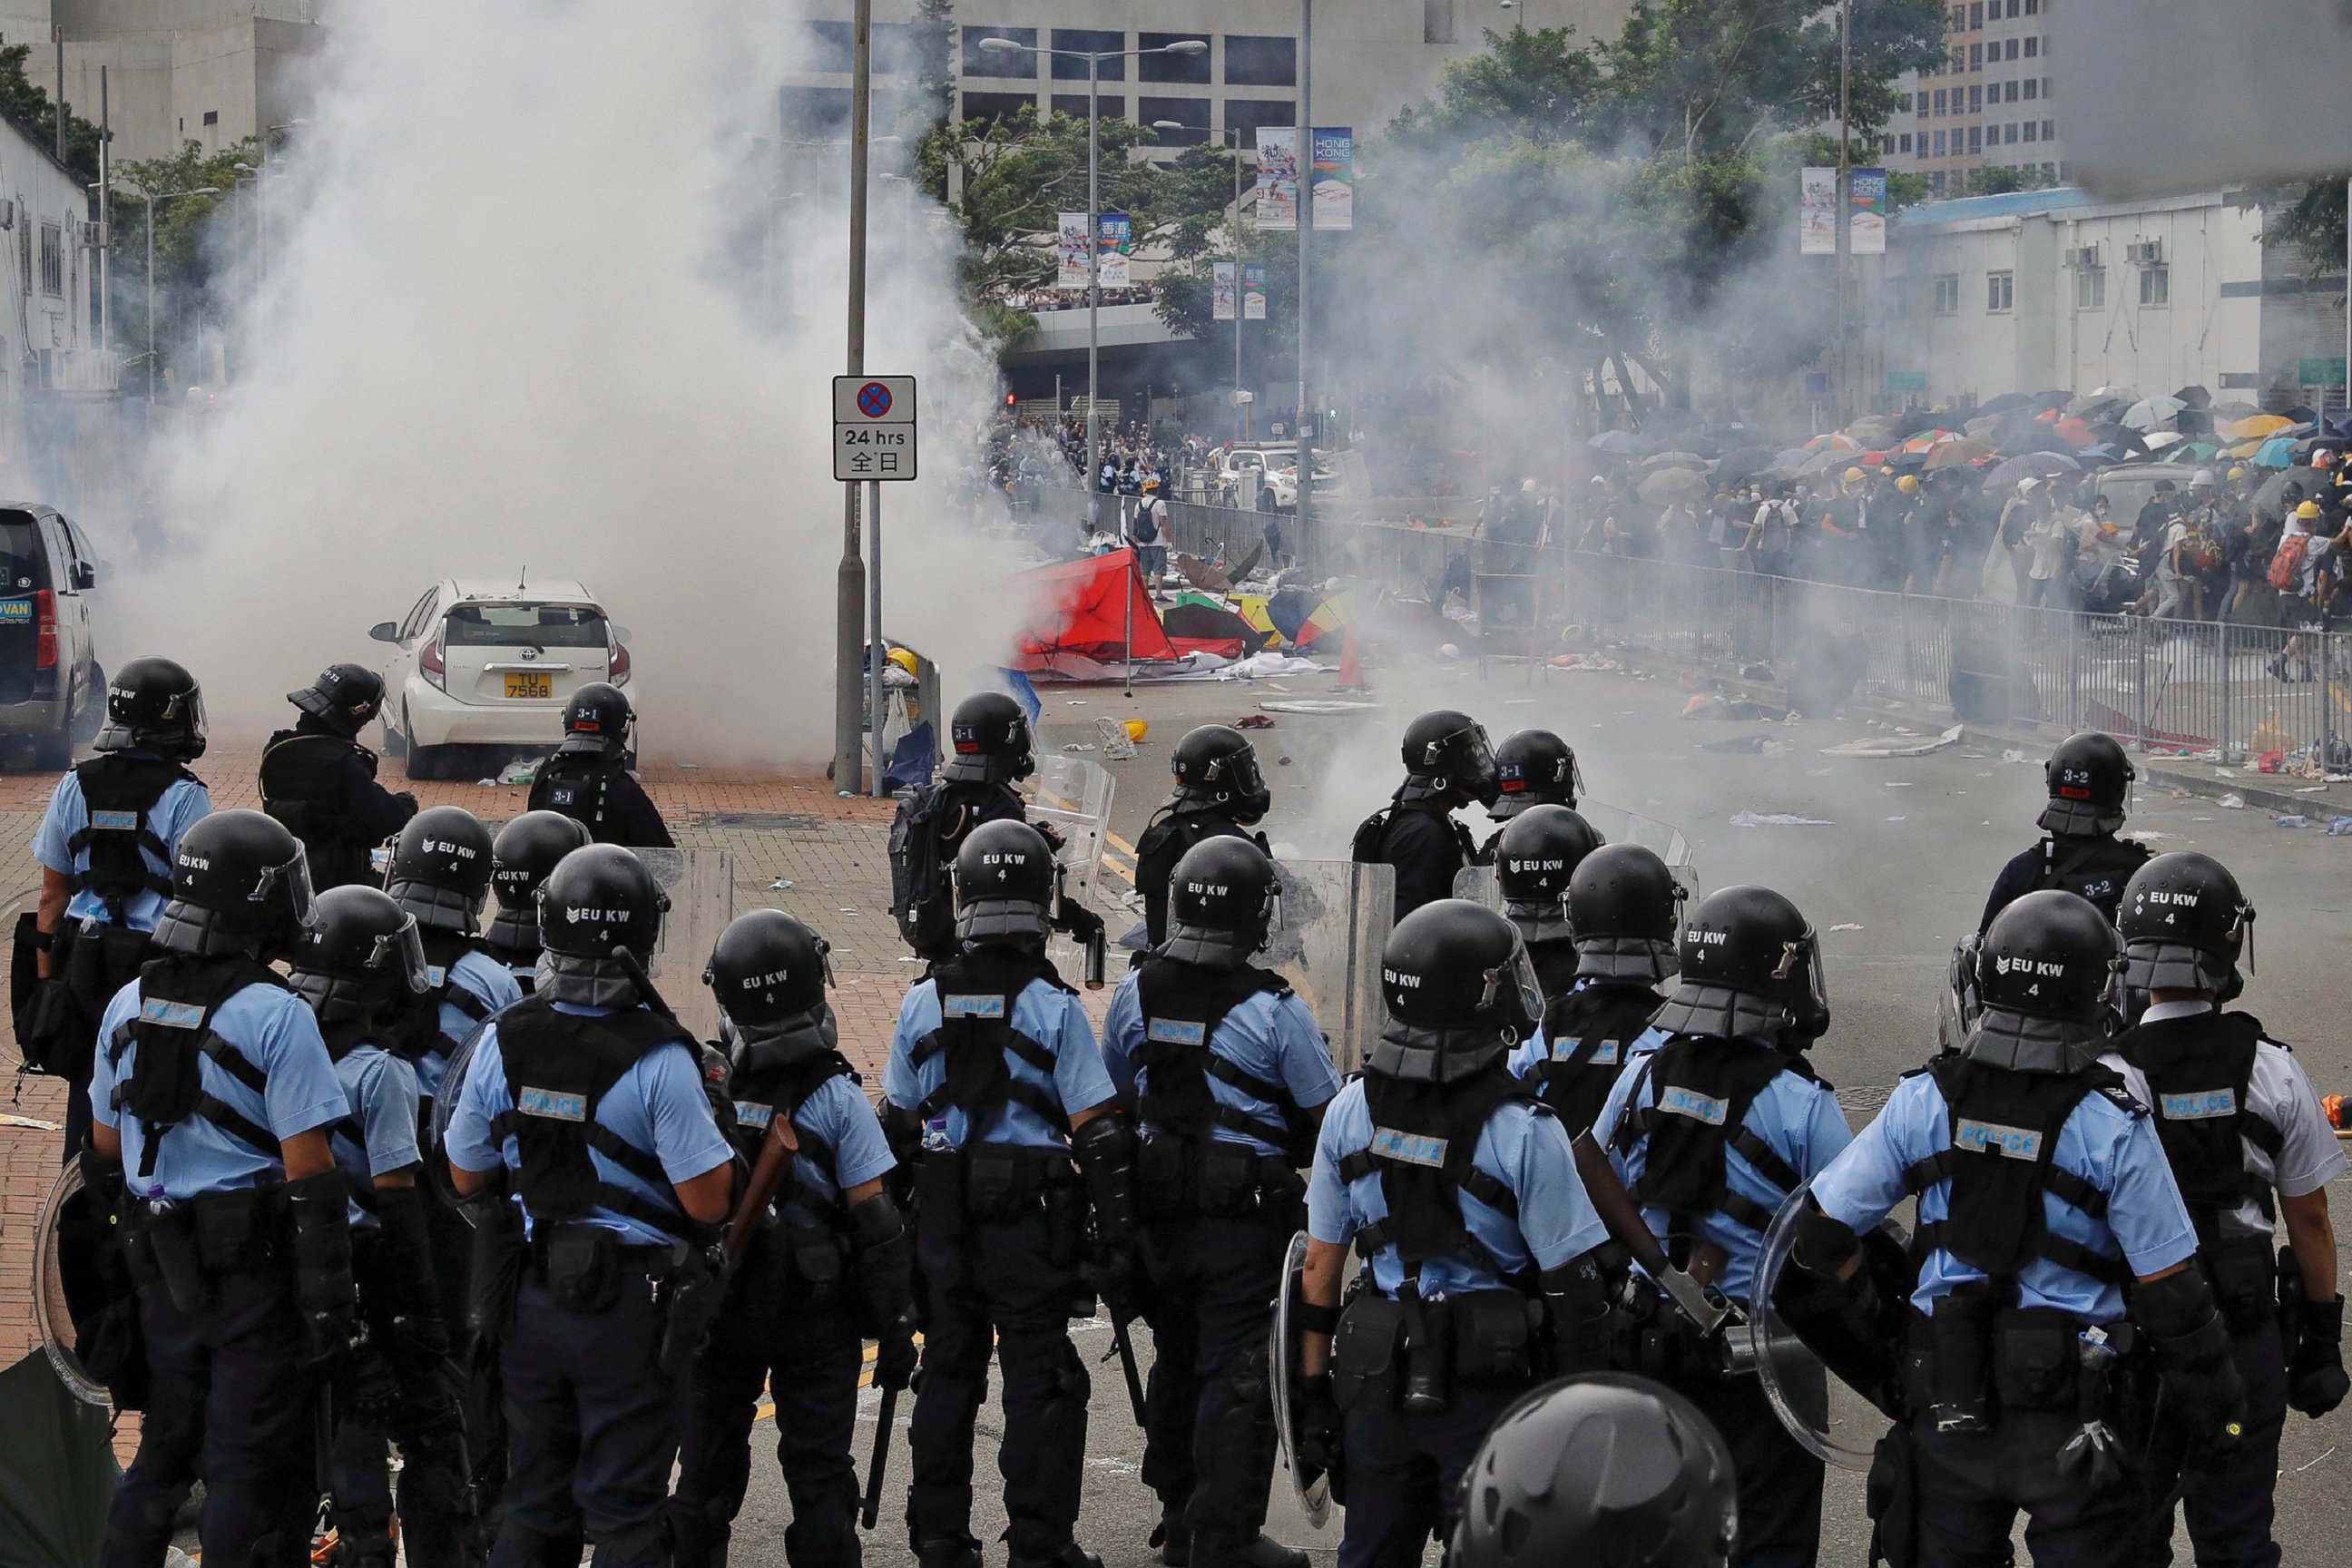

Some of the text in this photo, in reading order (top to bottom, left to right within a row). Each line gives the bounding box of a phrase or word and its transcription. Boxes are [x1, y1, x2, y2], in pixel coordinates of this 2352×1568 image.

[1316, 139, 1350, 148] HONG
[1316, 149, 1350, 157] KONG
[1853, 178, 1883, 186] HONG
[845, 429, 905, 445] 24 hrs
[851, 452, 897, 472] 全日
[0, 603, 28, 615] VAN
[517, 673, 538, 685] TU
[112, 687, 135, 699] EU KW
[508, 685, 548, 697] 7568
[113, 700, 118, 708] 4
[577, 708, 597, 719] 3-1
[956, 728, 973, 740] 3-1
[1501, 764, 1520, 778] 3-1
[2063, 769, 2089, 784] 3-2
[554, 791, 571, 802] 3-1
[438, 842, 476, 859] EU KW
[179, 853, 210, 871] EU KW
[983, 853, 1025, 865] EU KW
[1524, 859, 1563, 870] EU KW
[449, 862, 457, 871] 4
[185, 875, 193, 886] 4
[510, 871, 530, 881] KW
[998, 869, 1006, 880] 4
[1539, 877, 1548, 887] 4
[2085, 879, 2112, 897] 3-2
[508, 885, 515, 894] 4
[1188, 882, 1229, 896] EU KW
[1199, 896, 1207, 906] 4
[2150, 891, 2198, 906] EU KW
[580, 907, 631, 923] EU KW
[2164, 913, 2175, 925] 4
[599, 930, 609, 942] 4
[1687, 930, 1726, 946] EU KW
[1697, 948, 1705, 961] 4
[2012, 957, 2064, 977] EU KW
[742, 969, 788, 989] EU KW
[1385, 968, 1421, 988] EU KW
[2028, 984, 2039, 995] 4
[766, 993, 774, 1004] 4
[1397, 994, 1405, 1005] 4
[949, 1000, 1002, 1013] POLICE
[146, 1004, 199, 1024] POLICE
[1153, 1022, 1200, 1039] POLICE
[523, 1092, 582, 1116] POLICE
[1666, 1091, 1722, 1119] POLICE
[2165, 1094, 2230, 1112] POLICE
[1378, 1132, 1442, 1160] POLICE
